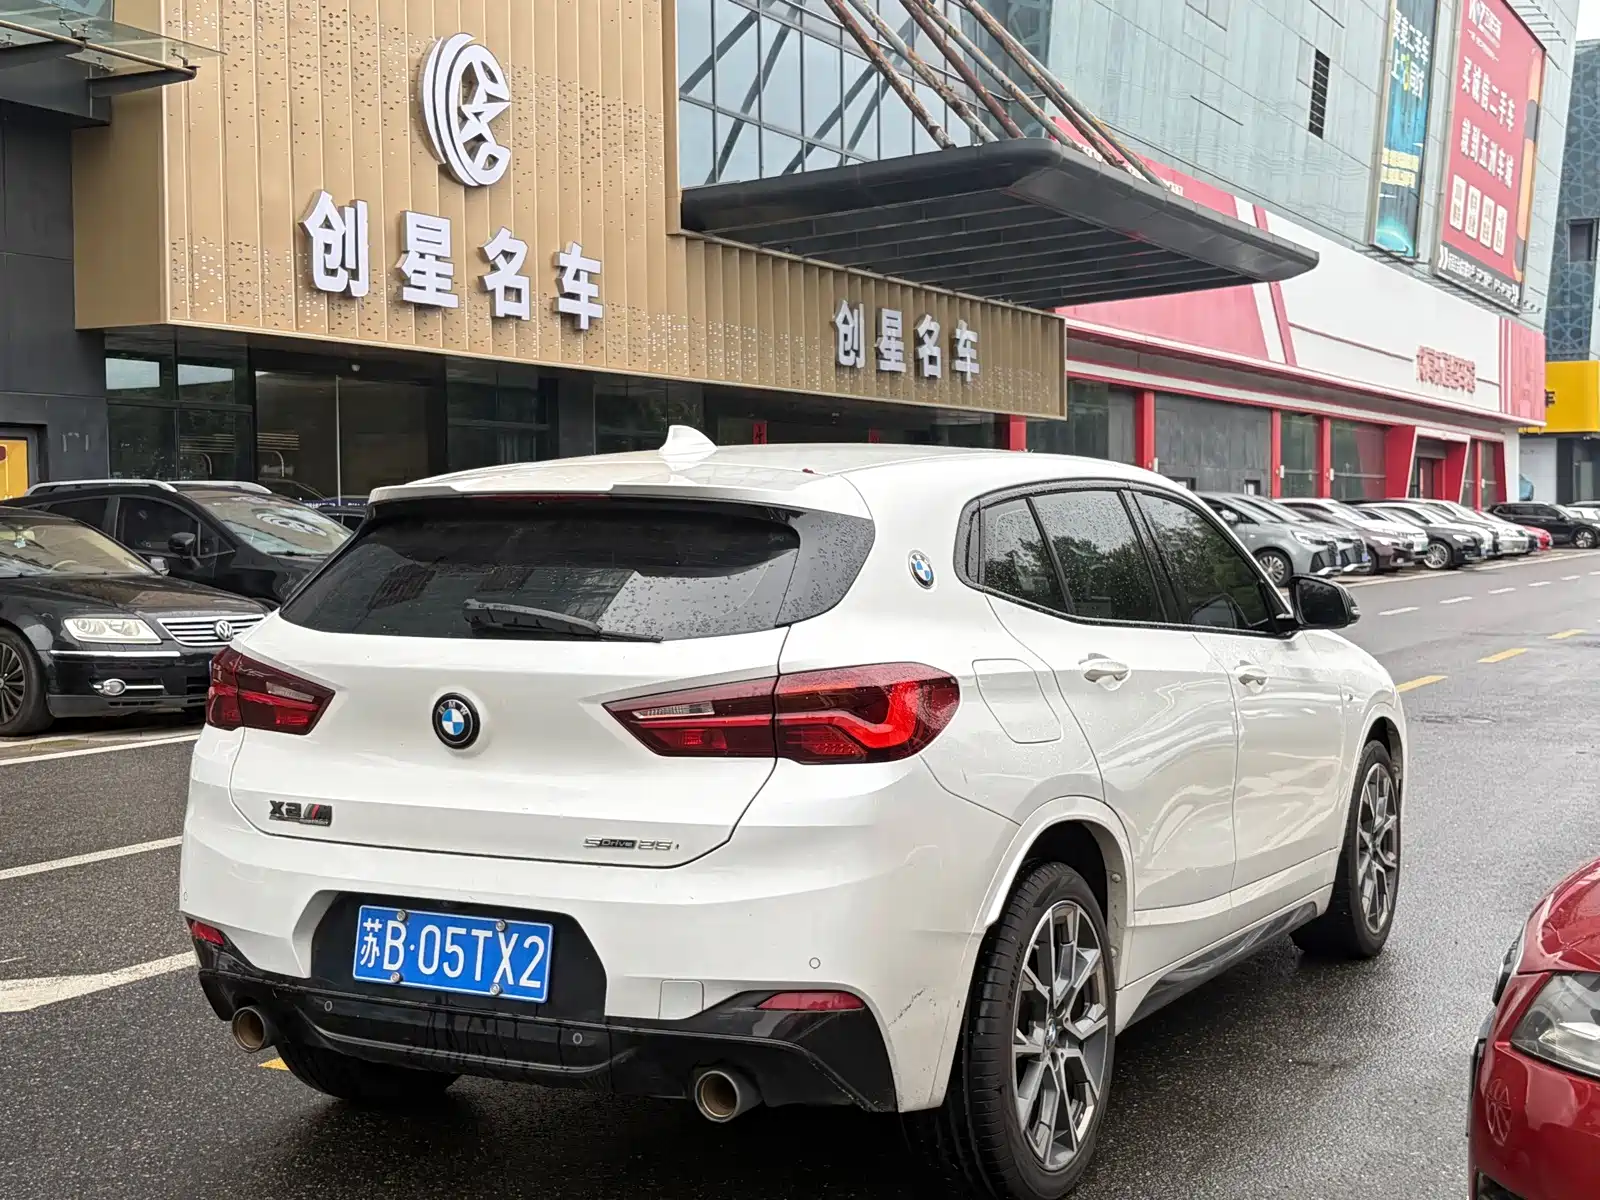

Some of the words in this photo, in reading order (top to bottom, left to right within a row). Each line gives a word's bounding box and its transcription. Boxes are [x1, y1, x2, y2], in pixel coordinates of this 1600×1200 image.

[300, 190, 603, 330] 创星名车
[834, 300, 980, 382] 创星名车
